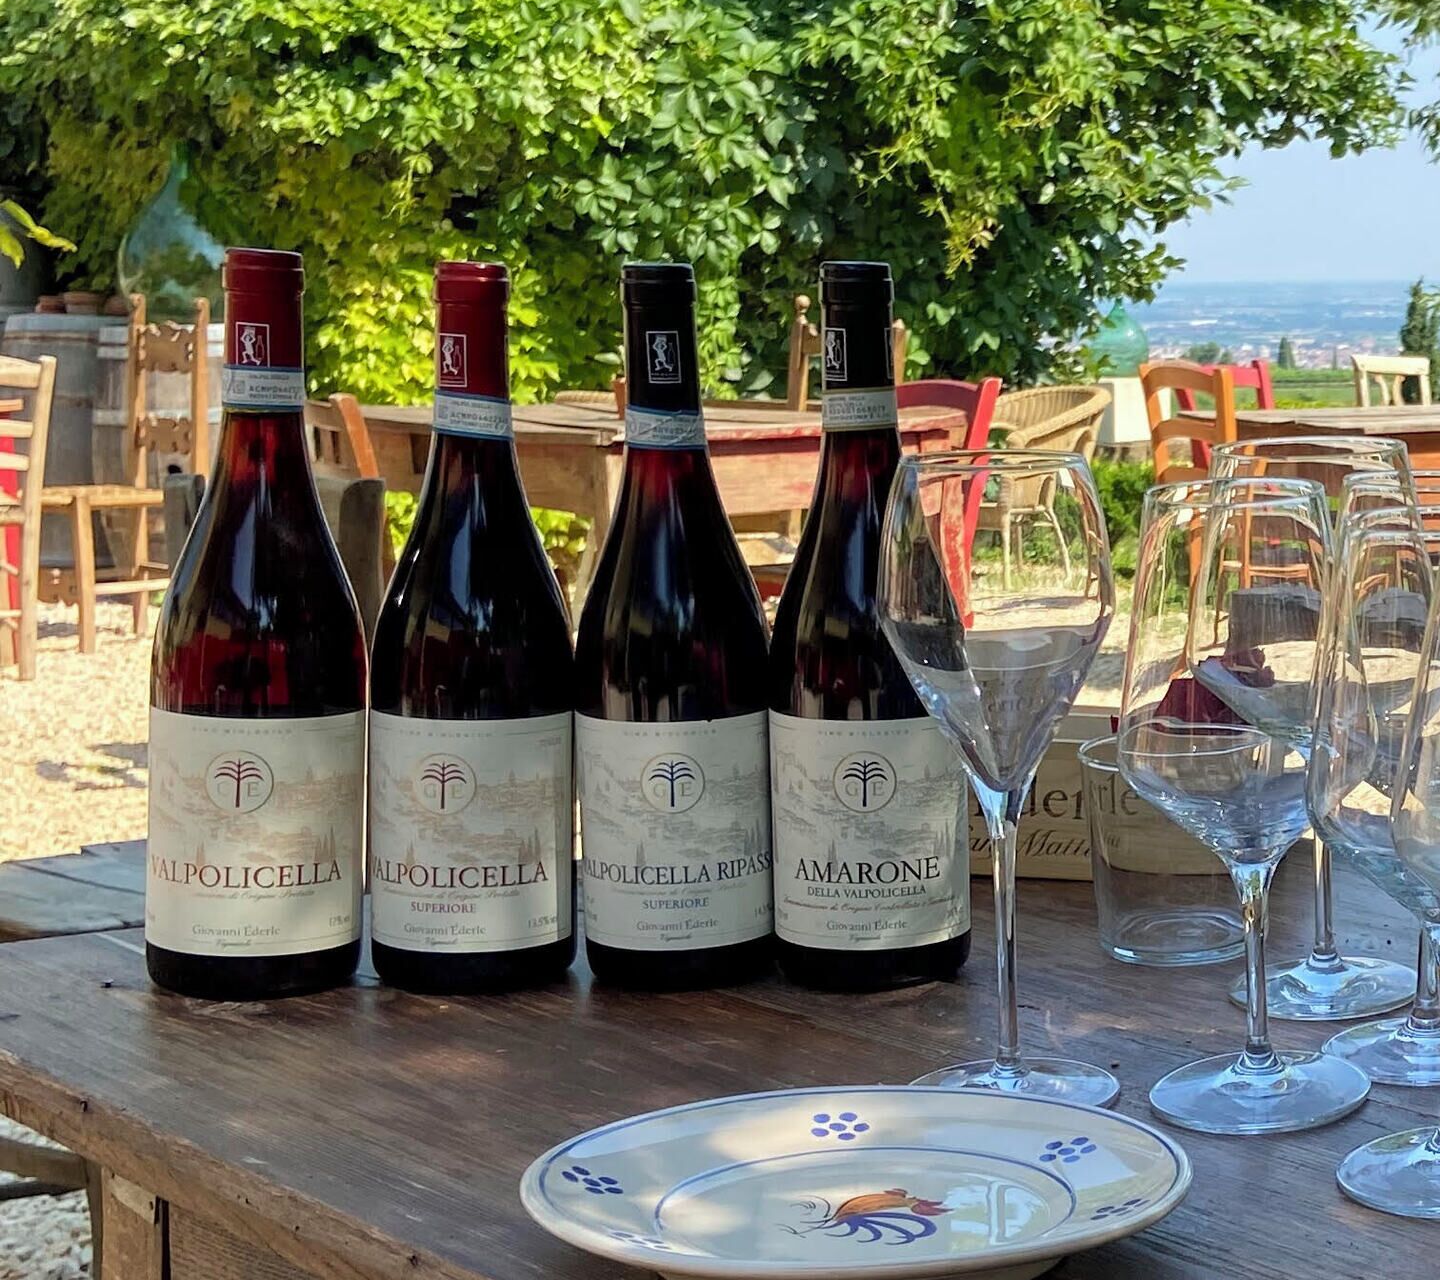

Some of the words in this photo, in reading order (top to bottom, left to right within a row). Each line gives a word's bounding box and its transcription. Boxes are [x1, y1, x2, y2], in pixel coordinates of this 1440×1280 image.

[151, 853, 342, 889] VALPOLICELLA
[716, 850, 773, 881] RIPASS
[794, 855, 941, 885] AMARONE
[807, 886, 841, 898] DELLA
[844, 884, 927, 899] VALPOLICELLA
[410, 901, 477, 914] SUPERIORE
[641, 898, 710, 911] SUPERIORE
